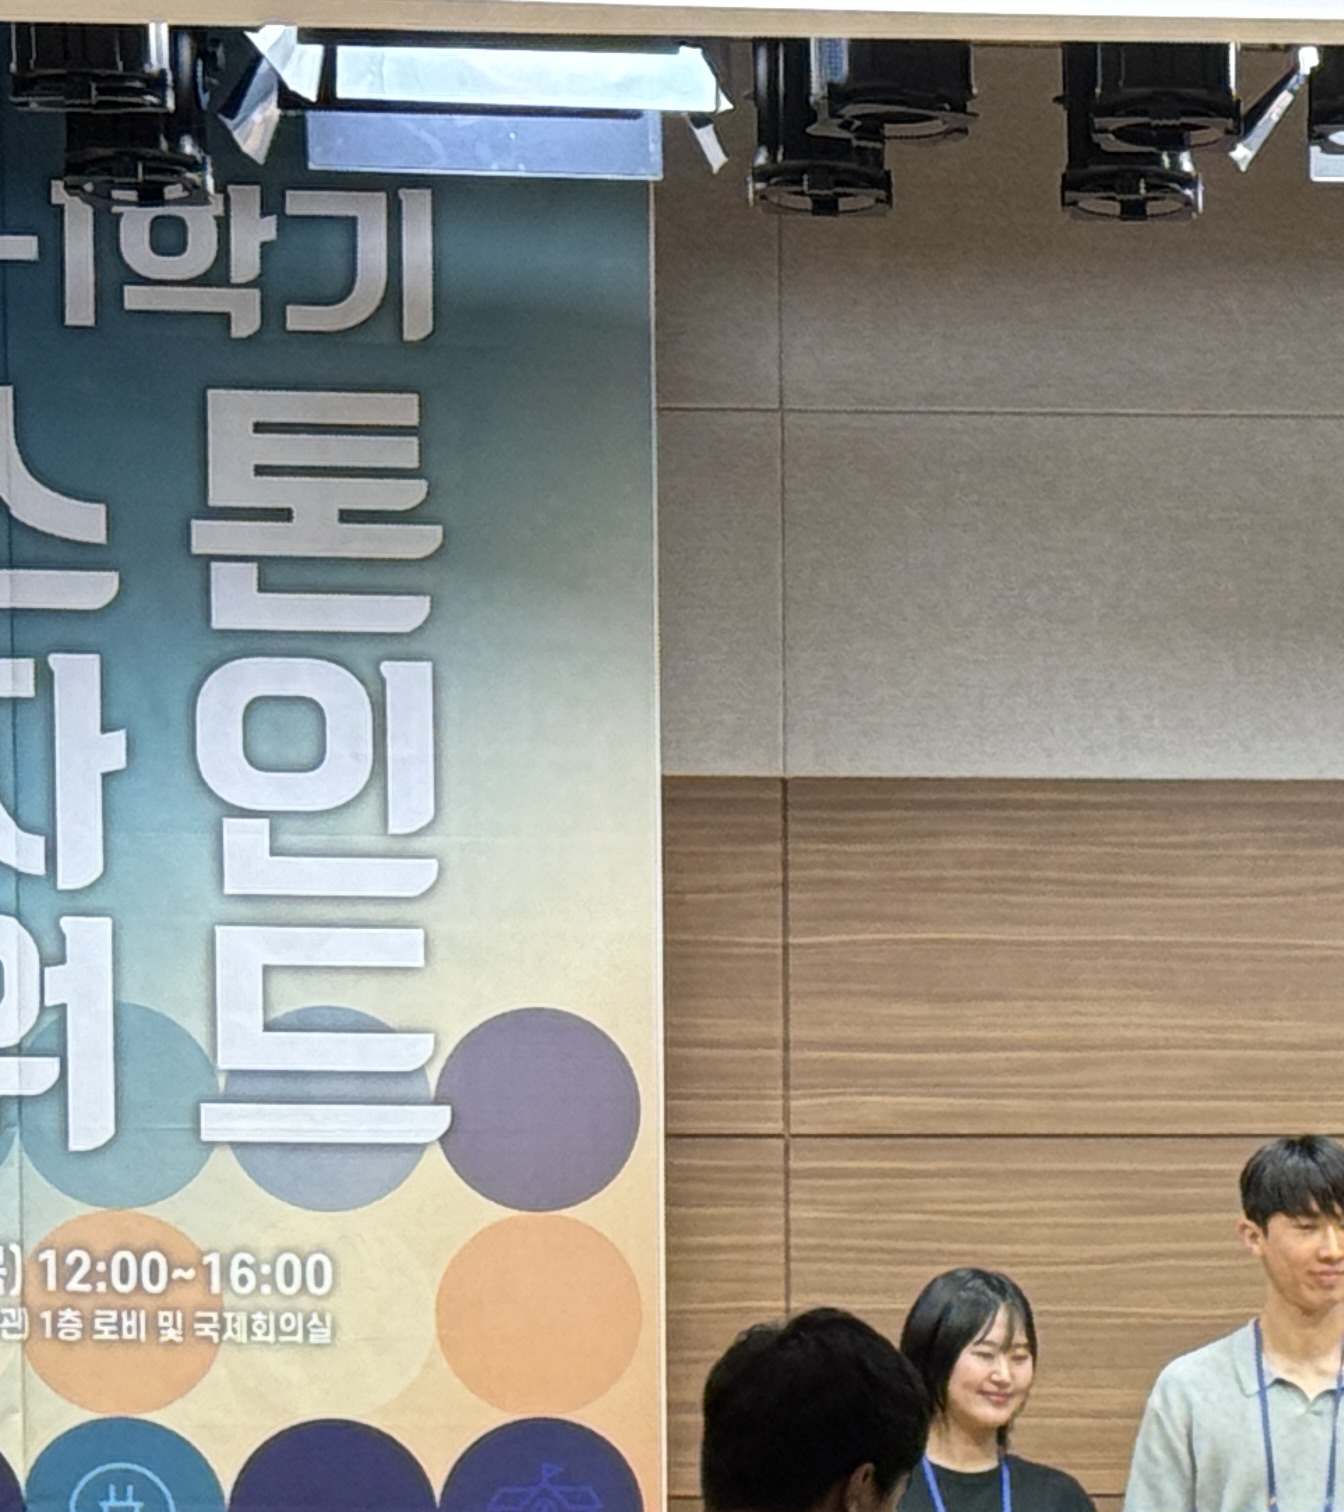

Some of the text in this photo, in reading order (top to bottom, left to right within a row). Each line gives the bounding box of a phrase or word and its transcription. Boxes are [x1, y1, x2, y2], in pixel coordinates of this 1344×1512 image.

[38, 1249, 333, 1296] 12:00~16:00
[39, 1308, 83, 1342] 1층
[93, 1309, 146, 1342] 로비
[157, 1310, 184, 1343] 및
[193, 1310, 332, 1345] 국제회의실
